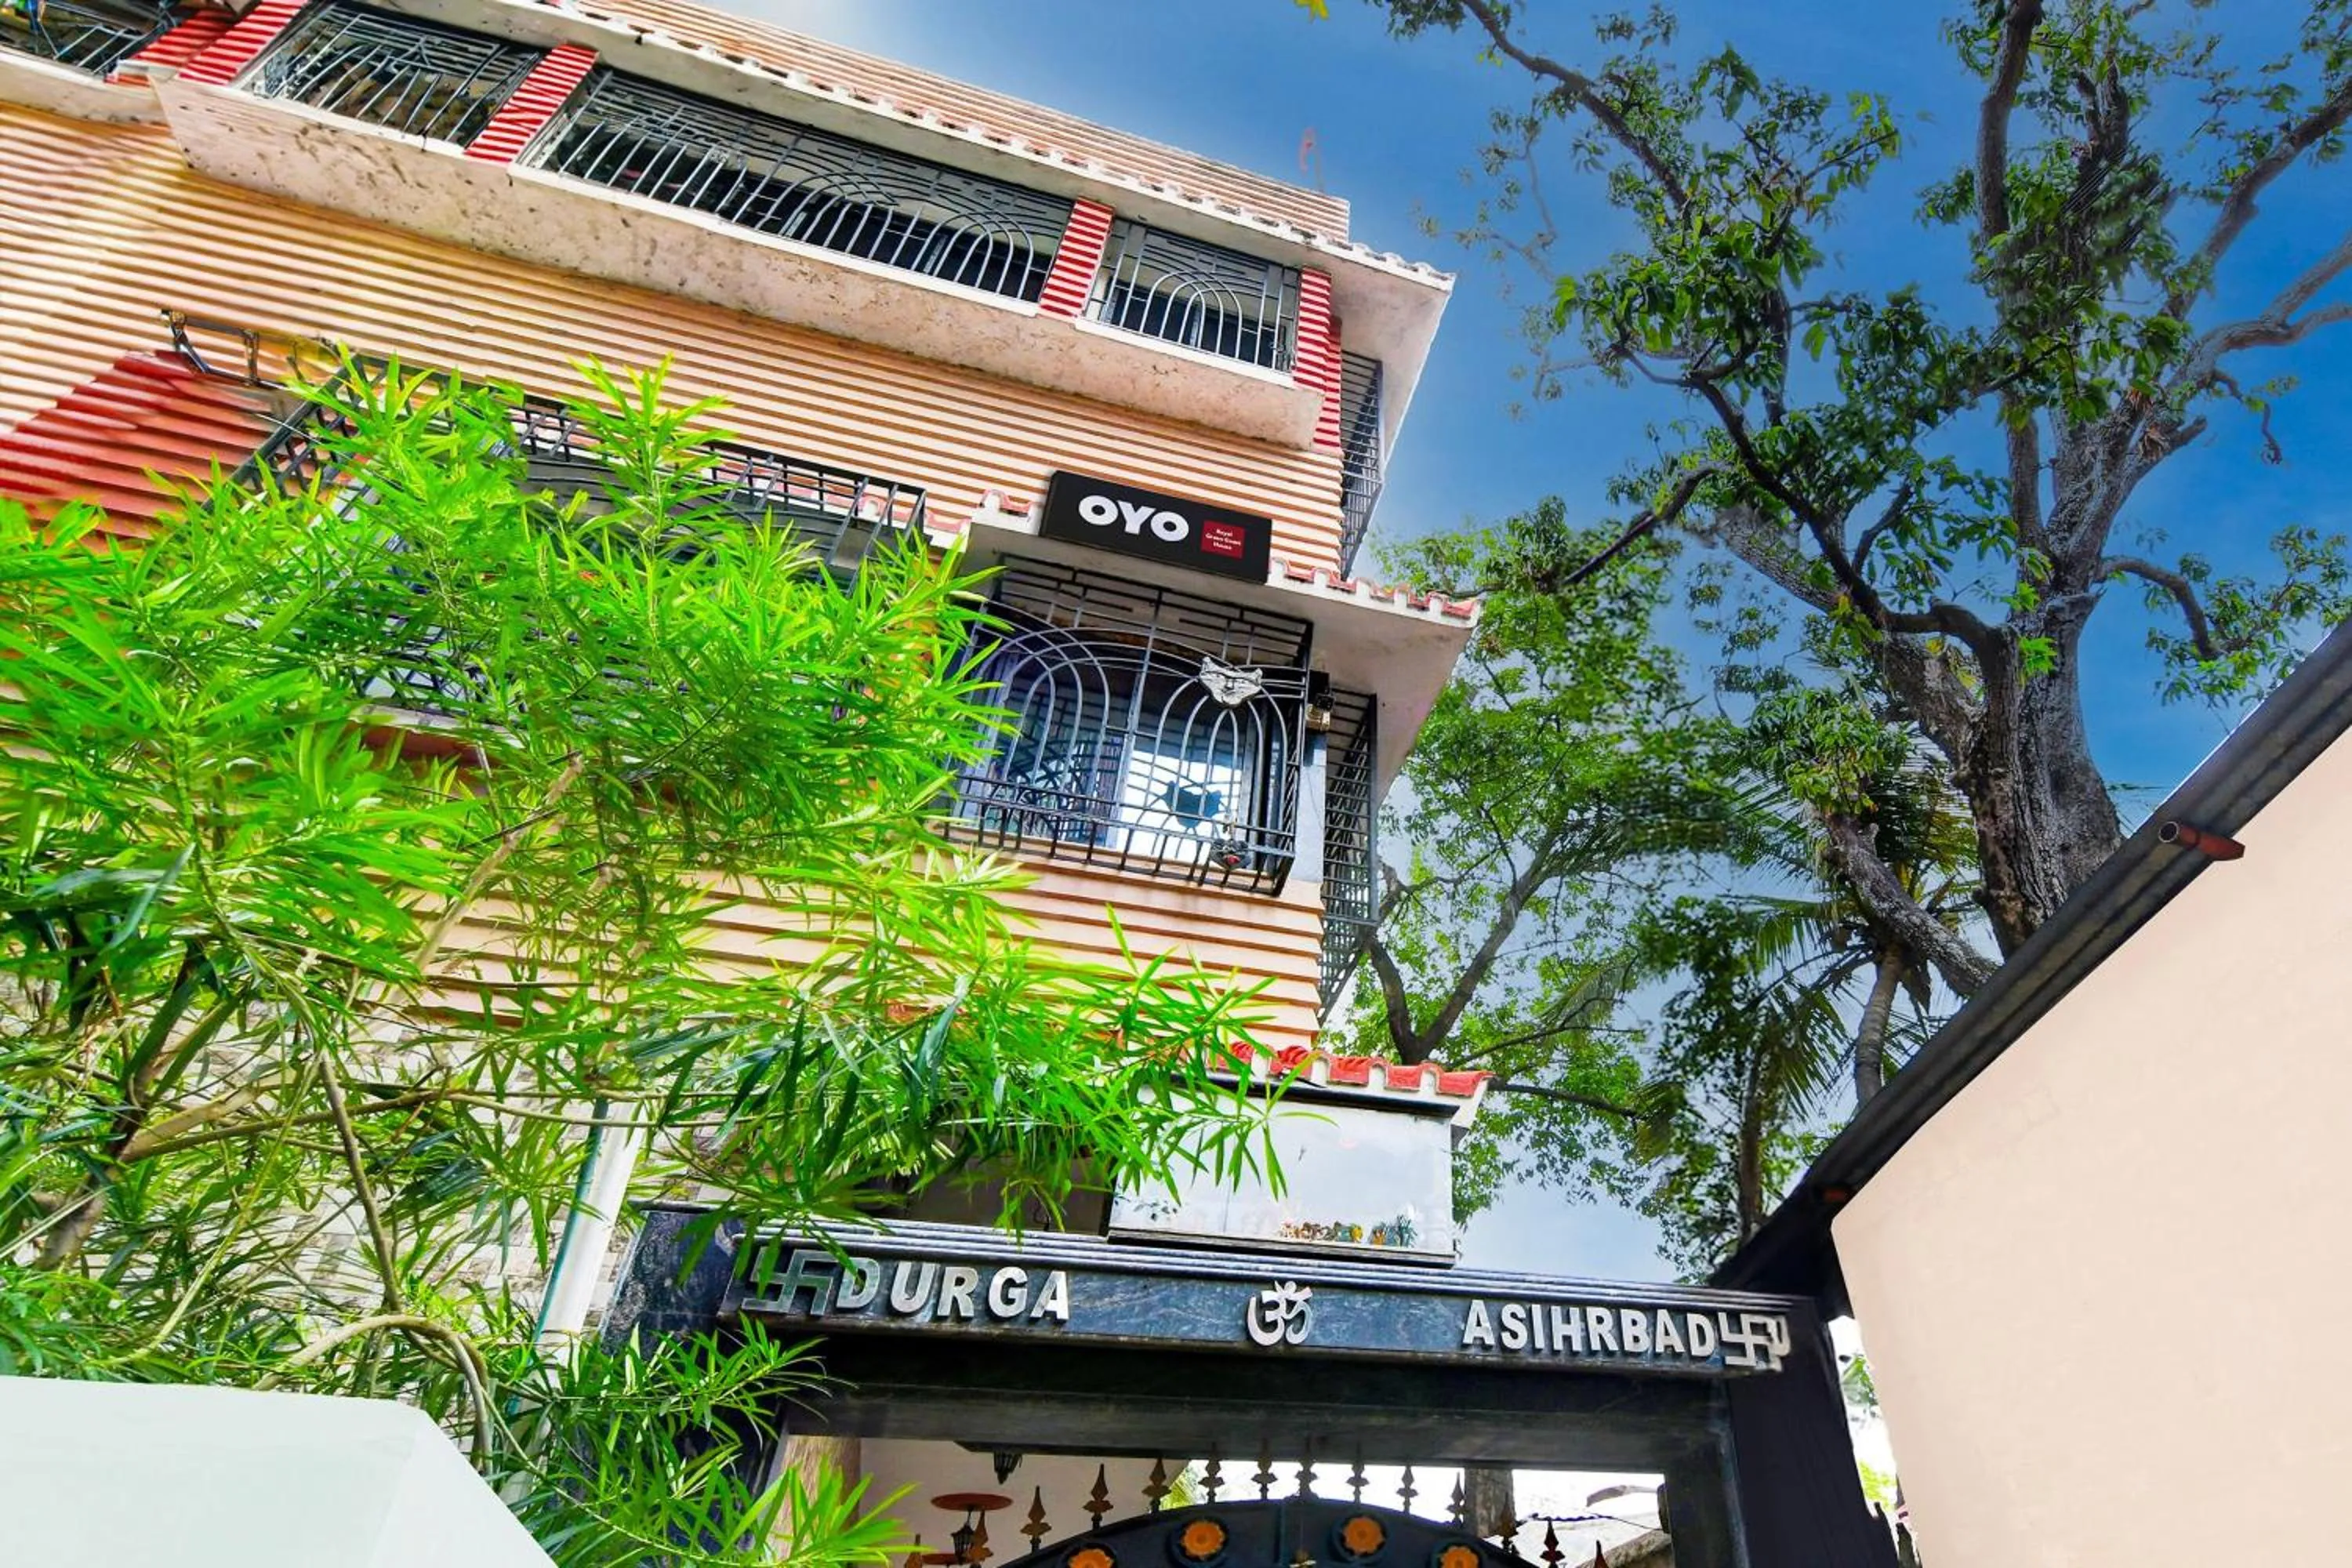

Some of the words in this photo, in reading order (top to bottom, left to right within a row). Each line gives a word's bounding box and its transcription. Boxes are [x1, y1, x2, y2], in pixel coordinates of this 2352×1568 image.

[1079, 495, 1189, 542] OYO
[837, 1258, 1069, 1320] DURGA
[1462, 1298, 1715, 1357] ASIHRBAD
